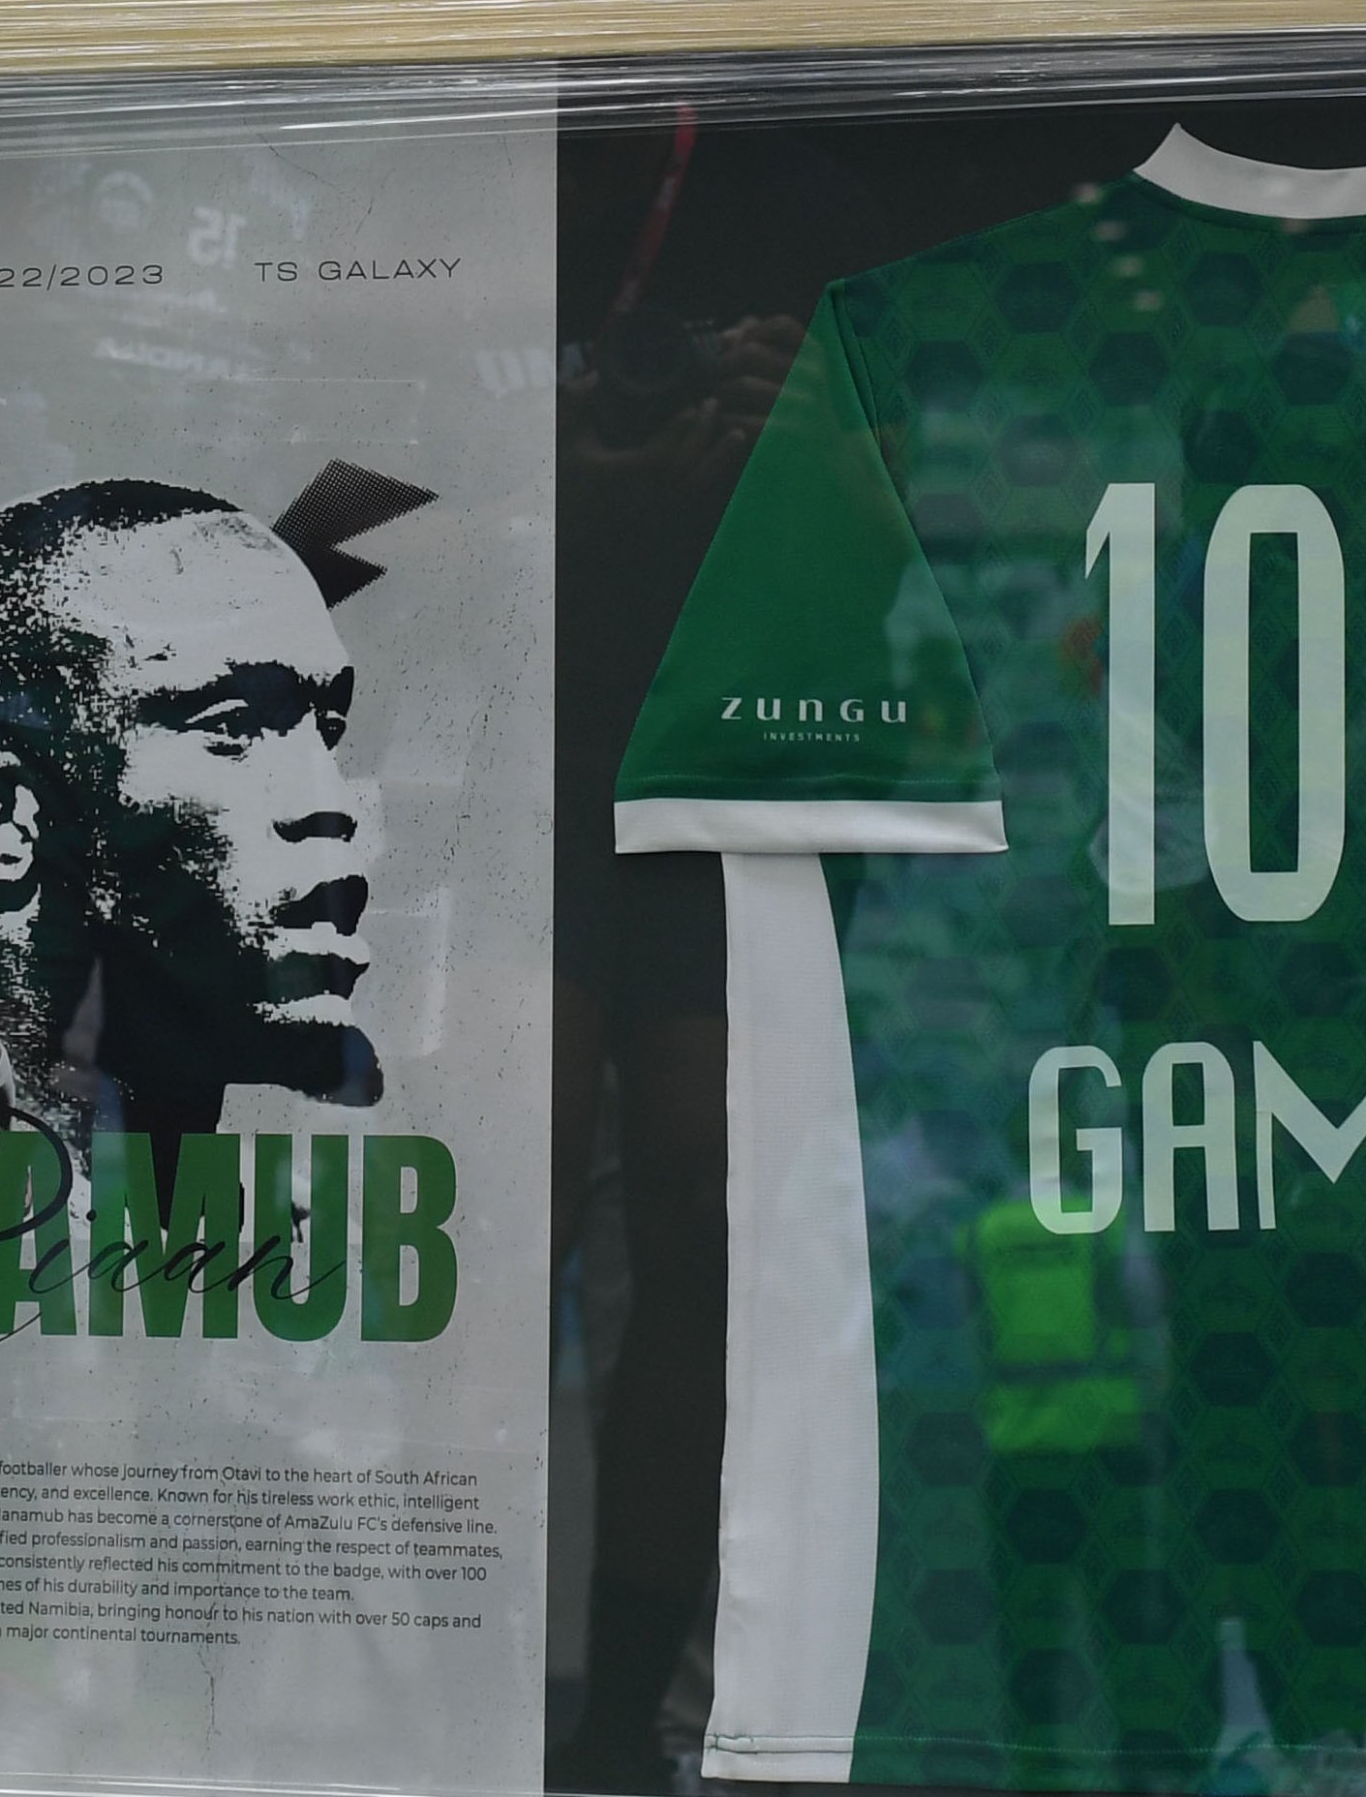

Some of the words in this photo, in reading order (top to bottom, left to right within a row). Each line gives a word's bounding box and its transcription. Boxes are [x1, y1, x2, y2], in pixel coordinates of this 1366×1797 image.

[254, 260, 298, 283] TS
[317, 257, 462, 282] GALAXY
[763, 732, 861, 742] INVESTMENTS
[70, 1462, 119, 1477] whose
[182, 1465, 218, 1478] from
[265, 1467, 281, 1480] to
[283, 1467, 309, 1481] the
[313, 1468, 353, 1482] heart
[356, 1469, 373, 1482] of
[375, 1469, 419, 1483] South
[422, 1470, 477, 1485] African
[41, 1485, 69, 1499] and
[73, 1486, 153, 1501] excellence.
[157, 1488, 209, 1502] Known
[212, 1489, 234, 1503] for
[236, 1490, 259, 1504] his
[261, 1490, 315, 1505] tireless
[317, 1491, 355, 1505] work
[357, 1492, 399, 1508] ethic,
[403, 1493, 480, 1512] intelligent
[67, 1509, 93, 1523] has
[97, 1510, 158, 1524] become
[161, 1515, 170, 1525] a
[173, 1511, 264, 1527] cornerstone
[265, 1514, 282, 1527] of
[283, 1514, 353, 1529] AmaZulu
[357, 1516, 388, 1530] FC's
[391, 1517, 463, 1532] defensive
[467, 1518, 497, 1532] line.
[31, 1531, 146, 1551] professionalism
[149, 1534, 179, 1548] and
[182, 1535, 243, 1553] passion,
[245, 1537, 305, 1555] earning
[306, 1538, 332, 1552] the
[335, 1539, 391, 1557] respect
[394, 1541, 411, 1554] of
[413, 1541, 503, 1558] teammates,
[87, 1555, 153, 1570] reflected
[157, 1557, 179, 1571] his
[181, 1558, 283, 1573] commitment
[285, 1560, 301, 1574] to
[303, 1561, 329, 1575] the
[333, 1561, 385, 1580] badge,
[387, 1563, 421, 1577] with
[425, 1567, 459, 1578] over
[460, 1565, 487, 1579] 100
[24, 1578, 41, 1592] of
[43, 1578, 65, 1592] his
[67, 1579, 139, 1598] durability
[141, 1581, 170, 1595] and
[173, 1582, 261, 1601] importance
[263, 1584, 281, 1598] to
[284, 1585, 309, 1599] the
[311, 1586, 355, 1600] team.
[28, 1601, 94, 1618] Namibia,
[97, 1603, 161, 1621] bringing
[165, 1605, 220, 1619] honour
[222, 1606, 239, 1620] to
[241, 1607, 263, 1621] his
[267, 1608, 315, 1622] nation
[318, 1609, 352, 1623] with
[355, 1614, 388, 1624] over
[391, 1611, 411, 1625] 50
[413, 1615, 449, 1629] caps
[452, 1613, 482, 1627] and
[6, 1625, 49, 1643] major
[52, 1626, 137, 1641] continental
[140, 1628, 241, 1644] tournaments.
